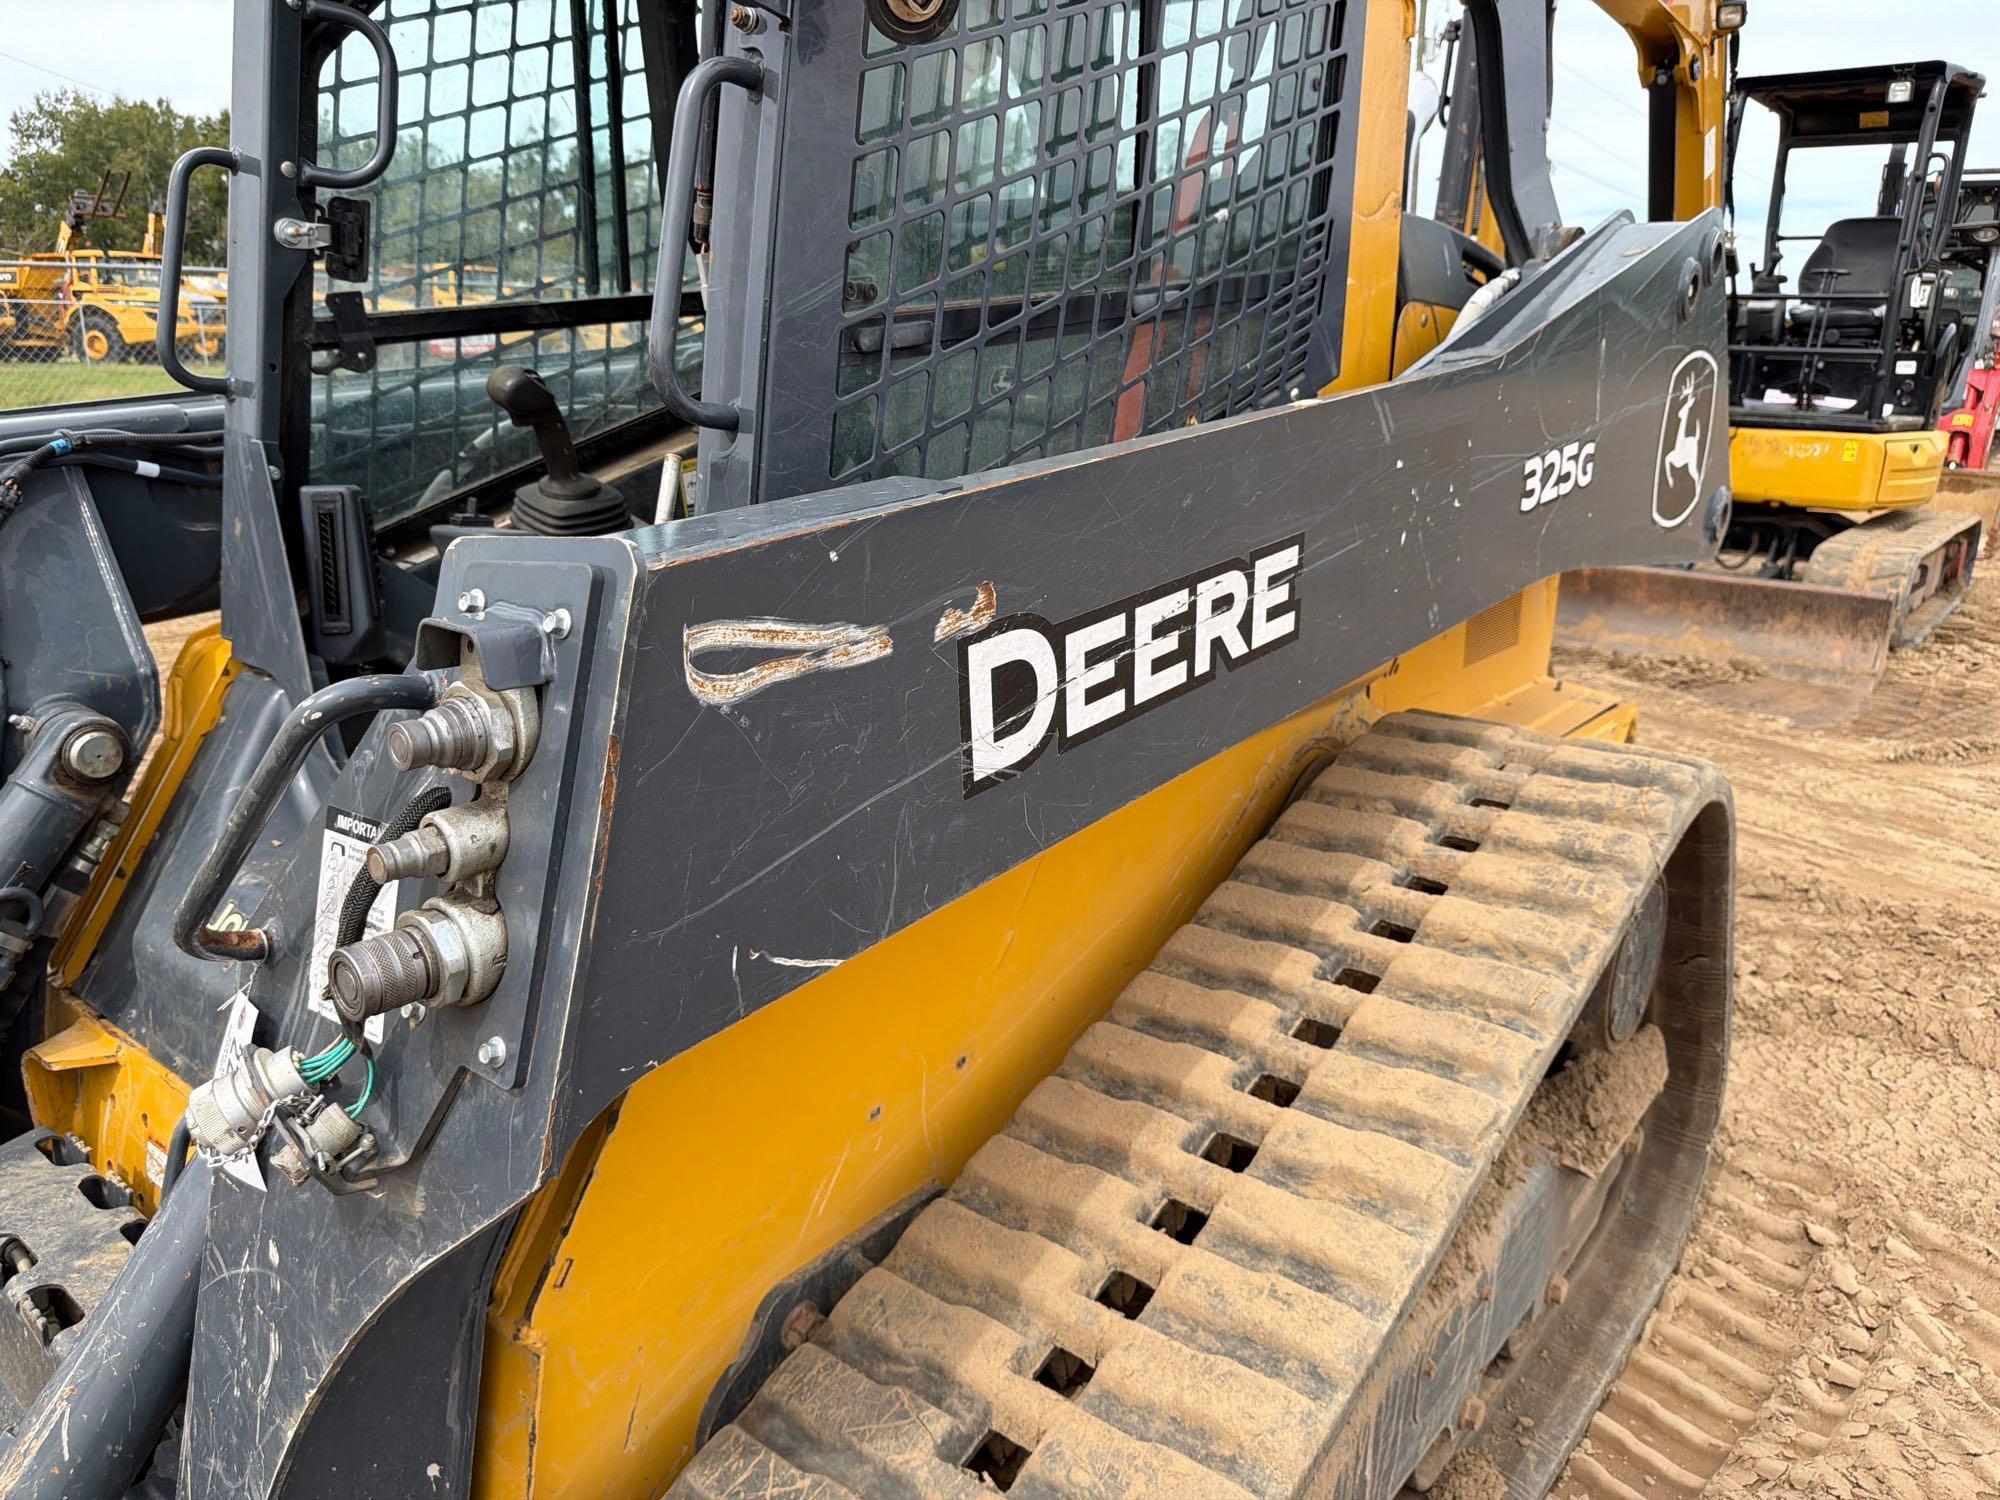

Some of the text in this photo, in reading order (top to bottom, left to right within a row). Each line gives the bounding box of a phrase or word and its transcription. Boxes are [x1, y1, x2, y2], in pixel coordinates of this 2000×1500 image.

[1520, 441, 1596, 512] 325G
[967, 544, 1300, 782] DEERE
[336, 814, 385, 839] IMPORTA
